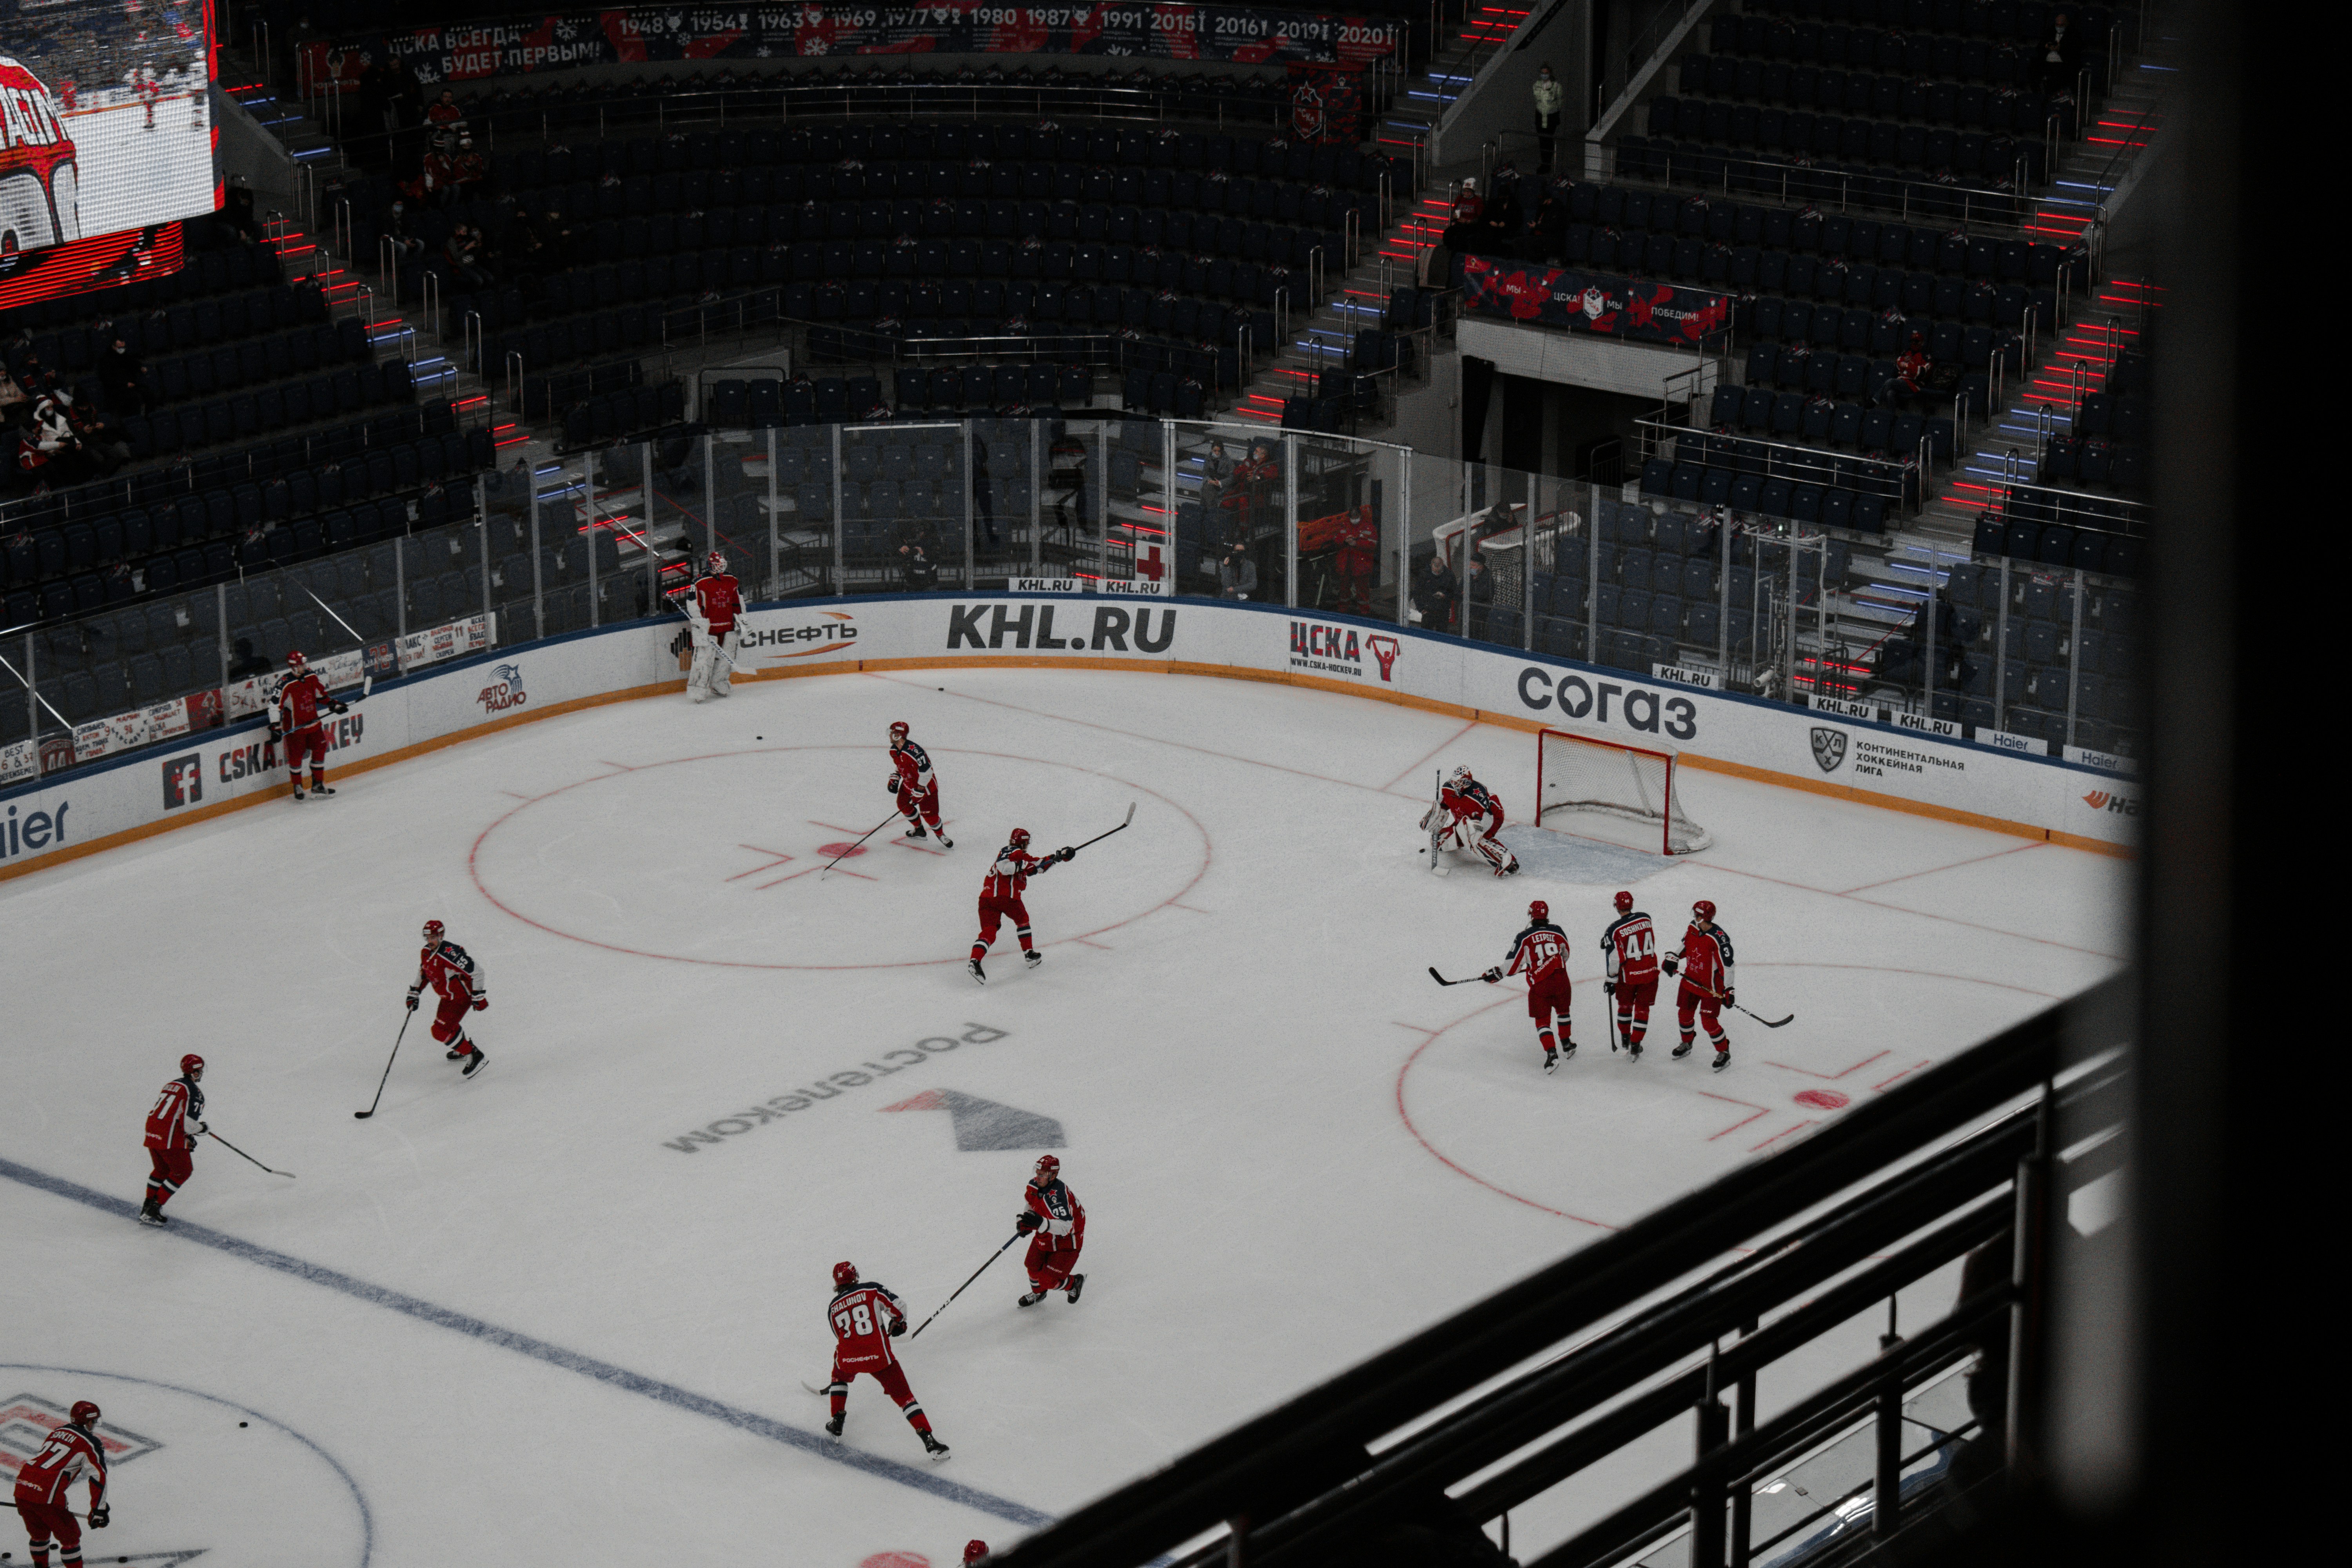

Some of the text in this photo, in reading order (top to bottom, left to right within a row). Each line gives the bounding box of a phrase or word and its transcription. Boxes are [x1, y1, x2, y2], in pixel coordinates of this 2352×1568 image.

[619, 17, 664, 35] 1948
[690, 14, 736, 32] 1954
[758, 12, 804, 29] 1963
[832, 10, 876, 27] 1969
[885, 8, 929, 26] 1977
[970, 9, 1017, 25] 1980
[1026, 9, 1070, 26] 1987
[1101, 11, 1142, 29] 1991
[1151, 13, 1195, 31] 2015
[1215, 16, 1259, 35] 2016
[1276, 21, 1319, 39] 2019
[1338, 25, 1383, 44] 2020
[389, 27, 522, 56] ЦСКА ВСЕГДА
[442, 41, 600, 74] БУДЕТ ПЕРВЫМ!
[1506, 284, 1521, 294] МЫ
[1554, 292, 1580, 303] ЦСКА!
[1608, 300, 1622, 310] МЫ
[1651, 307, 1699, 321] ПОБЕДИМ!
[1018, 579, 1073, 591] KHL.RU
[1105, 581, 1160, 594] KHL.RU
[947, 604, 1176, 653] KHL.RU
[1290, 621, 1361, 662] ЦСКА
[1290, 658, 1361, 677] WWW.CSKA-HOCKEY.RU
[1661, 667, 1710, 687] KHL.RU
[477, 683, 508, 704] АВТО
[486, 691, 526, 714] РАДИО
[1817, 698, 1869, 719] KHL.RU
[1900, 716, 1953, 735] KHL.RU
[1994, 734, 2028, 750] Haier
[5, 745, 24, 758] BEST
[1857, 741, 1964, 771] КОНТИНЕНТАЛЬНАЯ
[2082, 751, 2117, 768] Haier
[1855, 764, 1882, 777] ЛИГА
[1856, 752, 1922, 773] ХОККЕЙНАЯ
[1531, 933, 1555, 943] LEIPSIC
[1619, 921, 1652, 937] SOSHNIKOV
[1626, 931, 1654, 961] 44
[1723, 947, 1730, 957] 3
[456, 955, 468, 969] 55
[662, 1022, 1011, 1154] Ростелеком
[830, 1292, 867, 1316] SHALUNOV
[834, 1304, 873, 1339] 78
[842, 1355, 879, 1363] РОСНЕФТЬ
